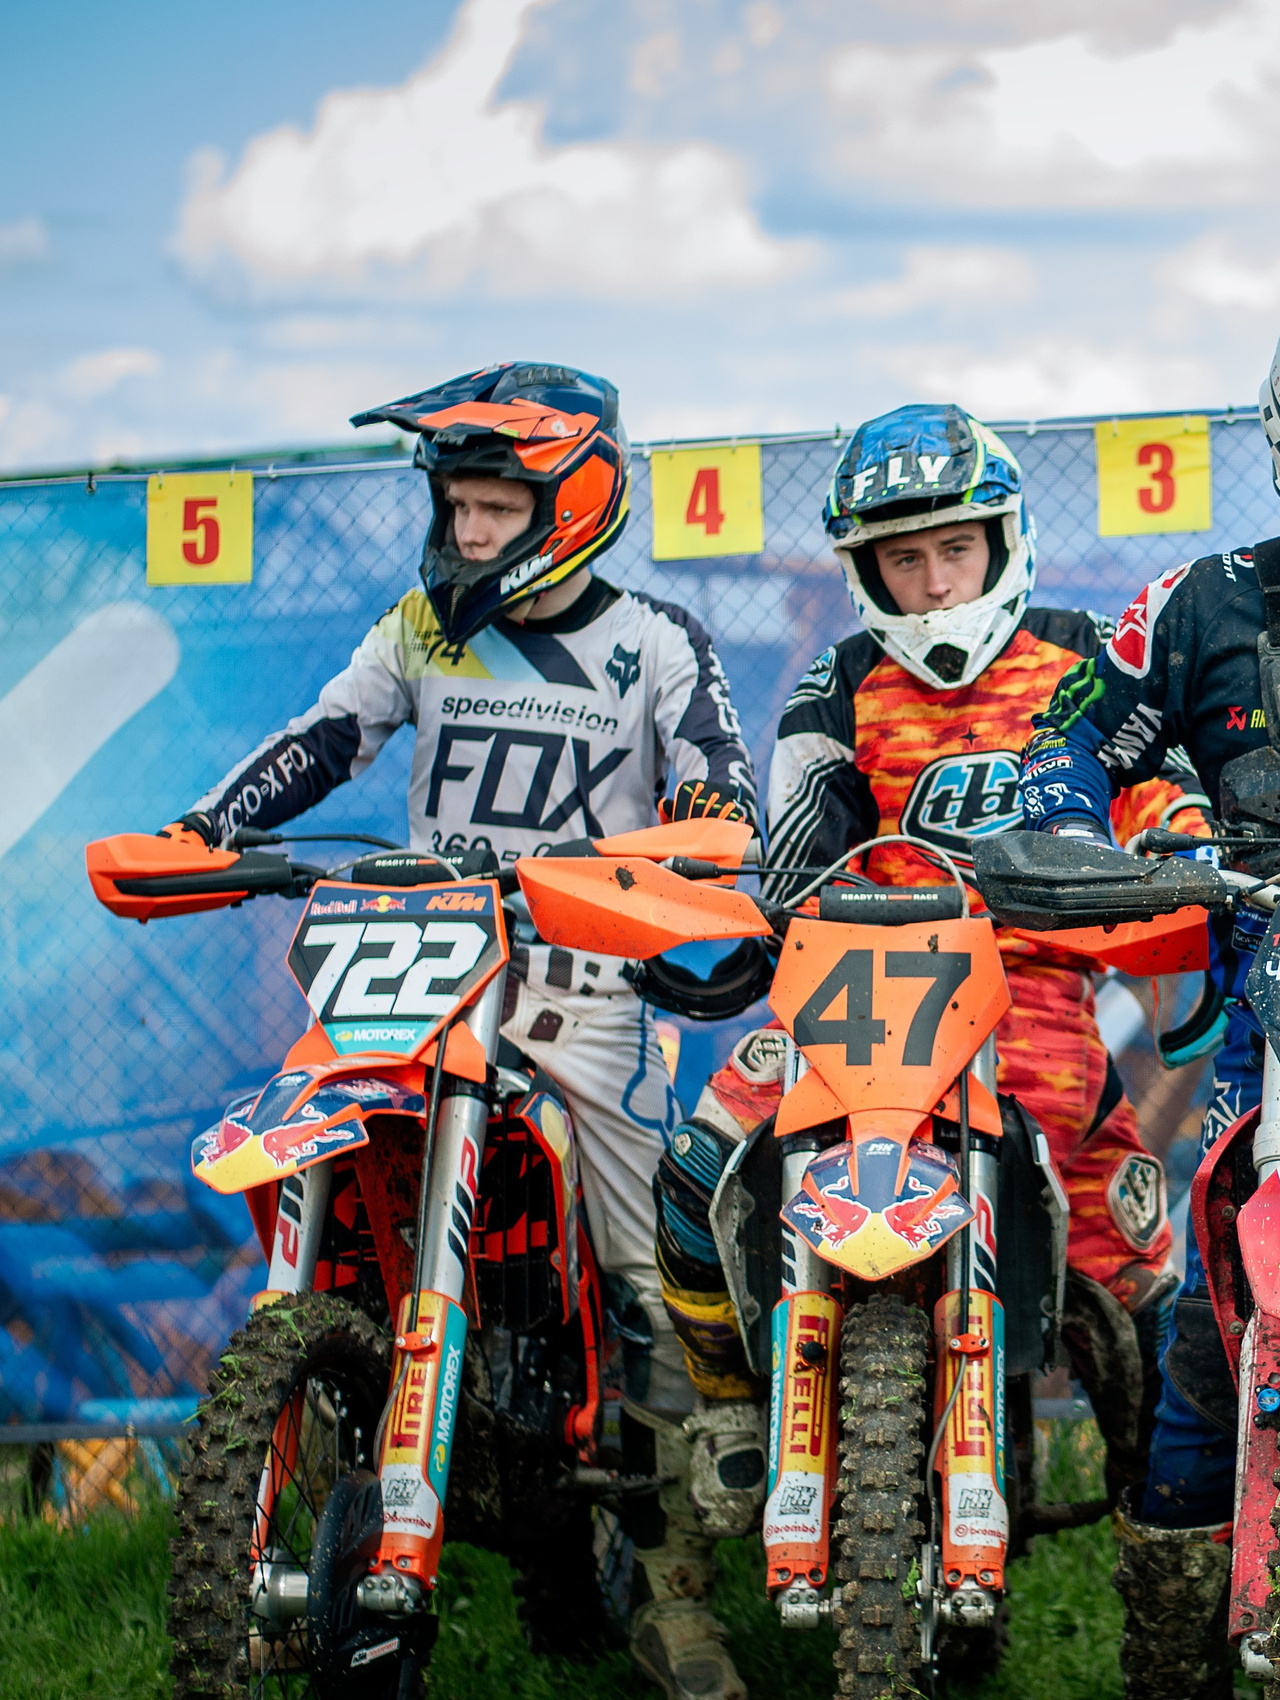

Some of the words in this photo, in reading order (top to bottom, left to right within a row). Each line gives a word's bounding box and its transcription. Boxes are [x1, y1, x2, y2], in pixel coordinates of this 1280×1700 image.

[685, 466, 725, 536] 4
[852, 455, 951, 502] FLY
[1137, 442, 1176, 514] 3
[181, 496, 221, 567] 5
[500, 552, 554, 596] KTM
[426, 628, 466, 666] 74
[441, 696, 618, 733] speedivision
[423, 722, 634, 834] FOX
[425, 892, 487, 912] KTM
[841, 893, 873, 901] READY
[874, 893, 887, 901] TO
[913, 893, 939, 901] RACE
[303, 921, 489, 1018] 722
[792, 949, 972, 1067] 47
[353, 1027, 416, 1043] MOTOREX
[436, 1343, 461, 1444] MOTOREX
[773, 1523, 817, 1536] brembo
